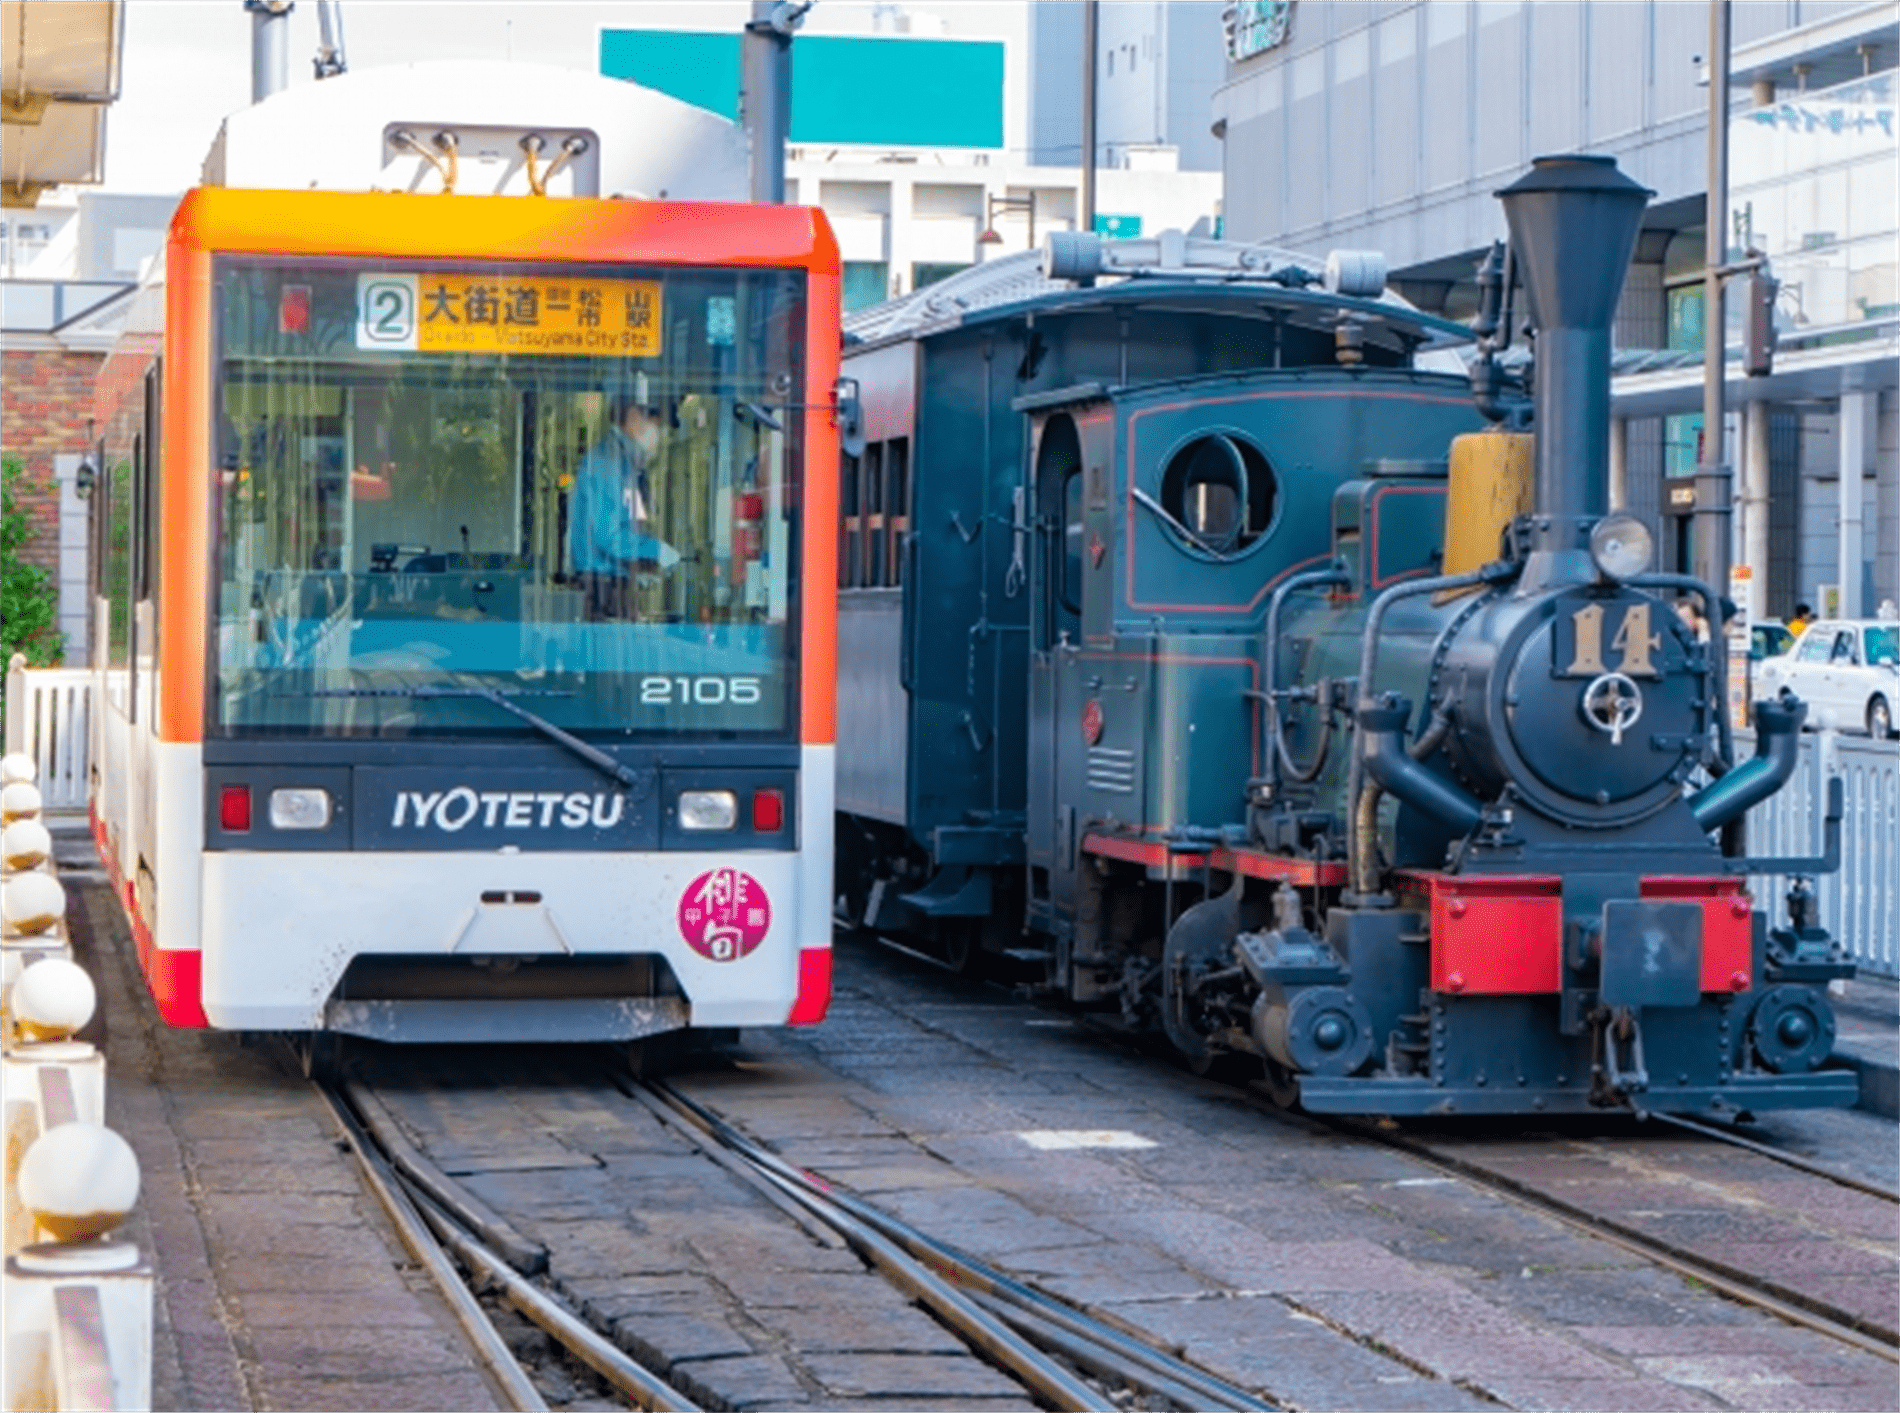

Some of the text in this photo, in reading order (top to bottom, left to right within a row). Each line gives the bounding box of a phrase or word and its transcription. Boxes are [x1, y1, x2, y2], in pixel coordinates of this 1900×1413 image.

[375, 282, 540, 333] 2 大街道
[1566, 603, 1661, 676] 14
[641, 677, 760, 704] 2105
[391, 786, 624, 831] IYOTETSU
